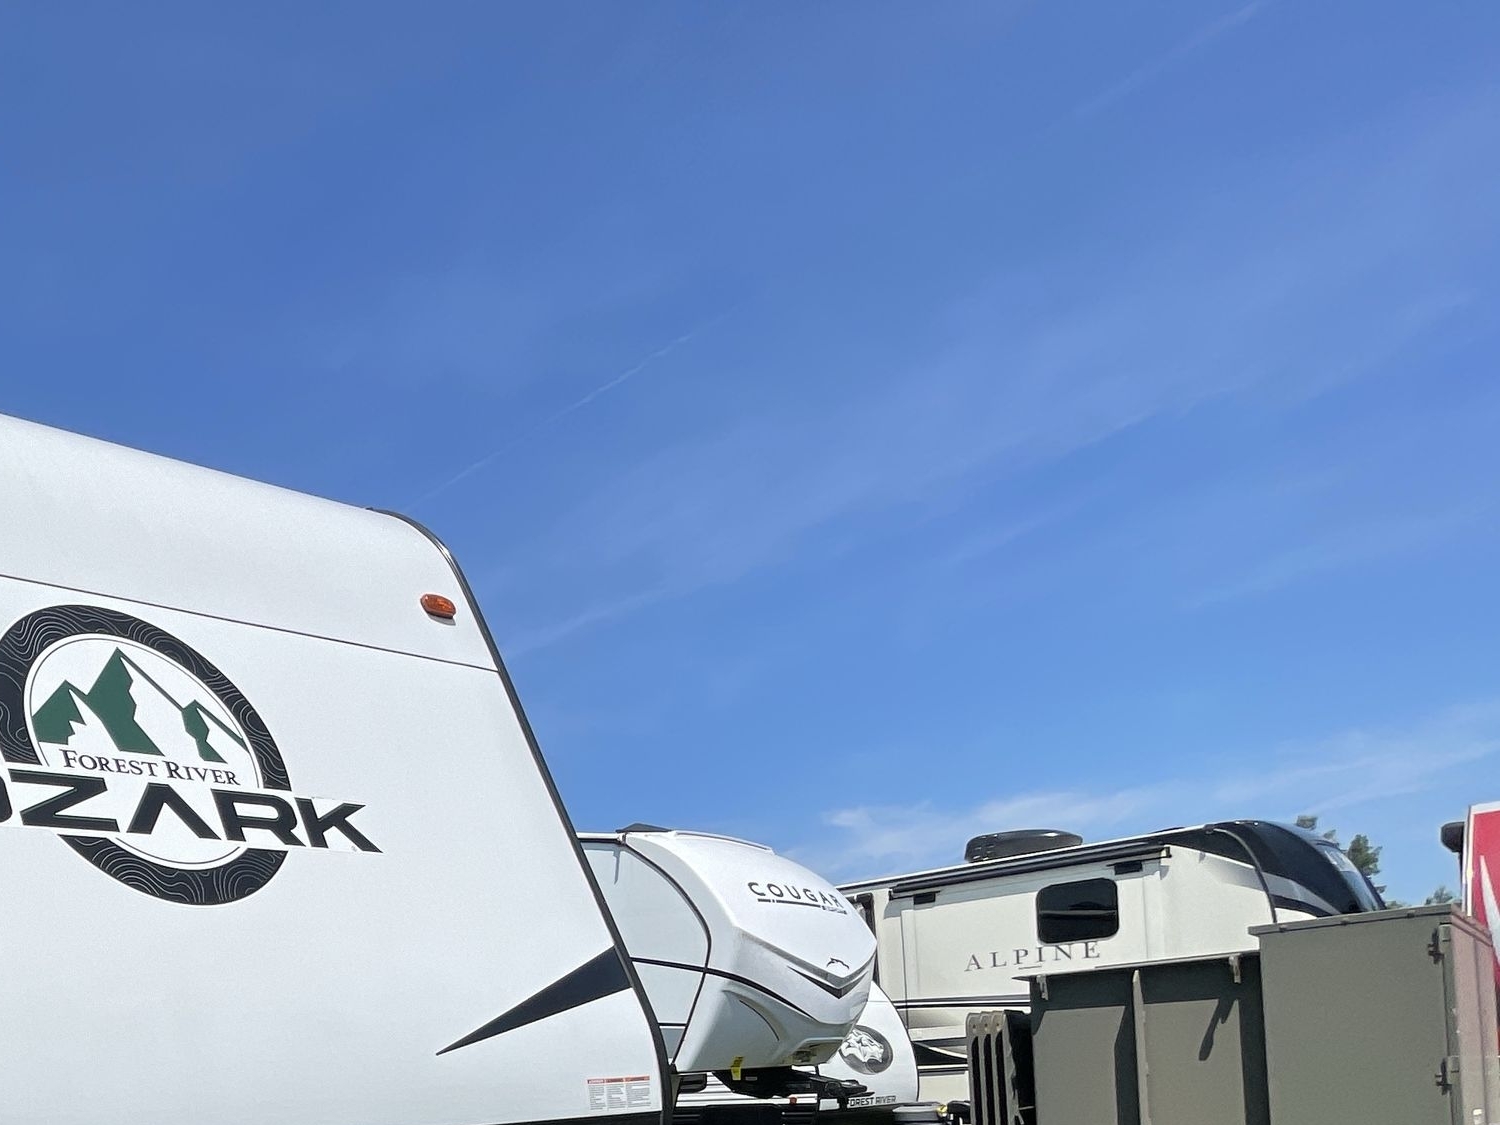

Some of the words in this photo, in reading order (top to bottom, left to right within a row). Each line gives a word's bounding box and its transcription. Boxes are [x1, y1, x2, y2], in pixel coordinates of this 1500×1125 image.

[59, 748, 158, 777] FOREST
[162, 760, 241, 786] RIVER
[747, 882, 844, 908] COUGAR
[964, 940, 1100, 972] ALPINE
[850, 1097, 874, 1106] OREST
[875, 1095, 896, 1104] RIVER
